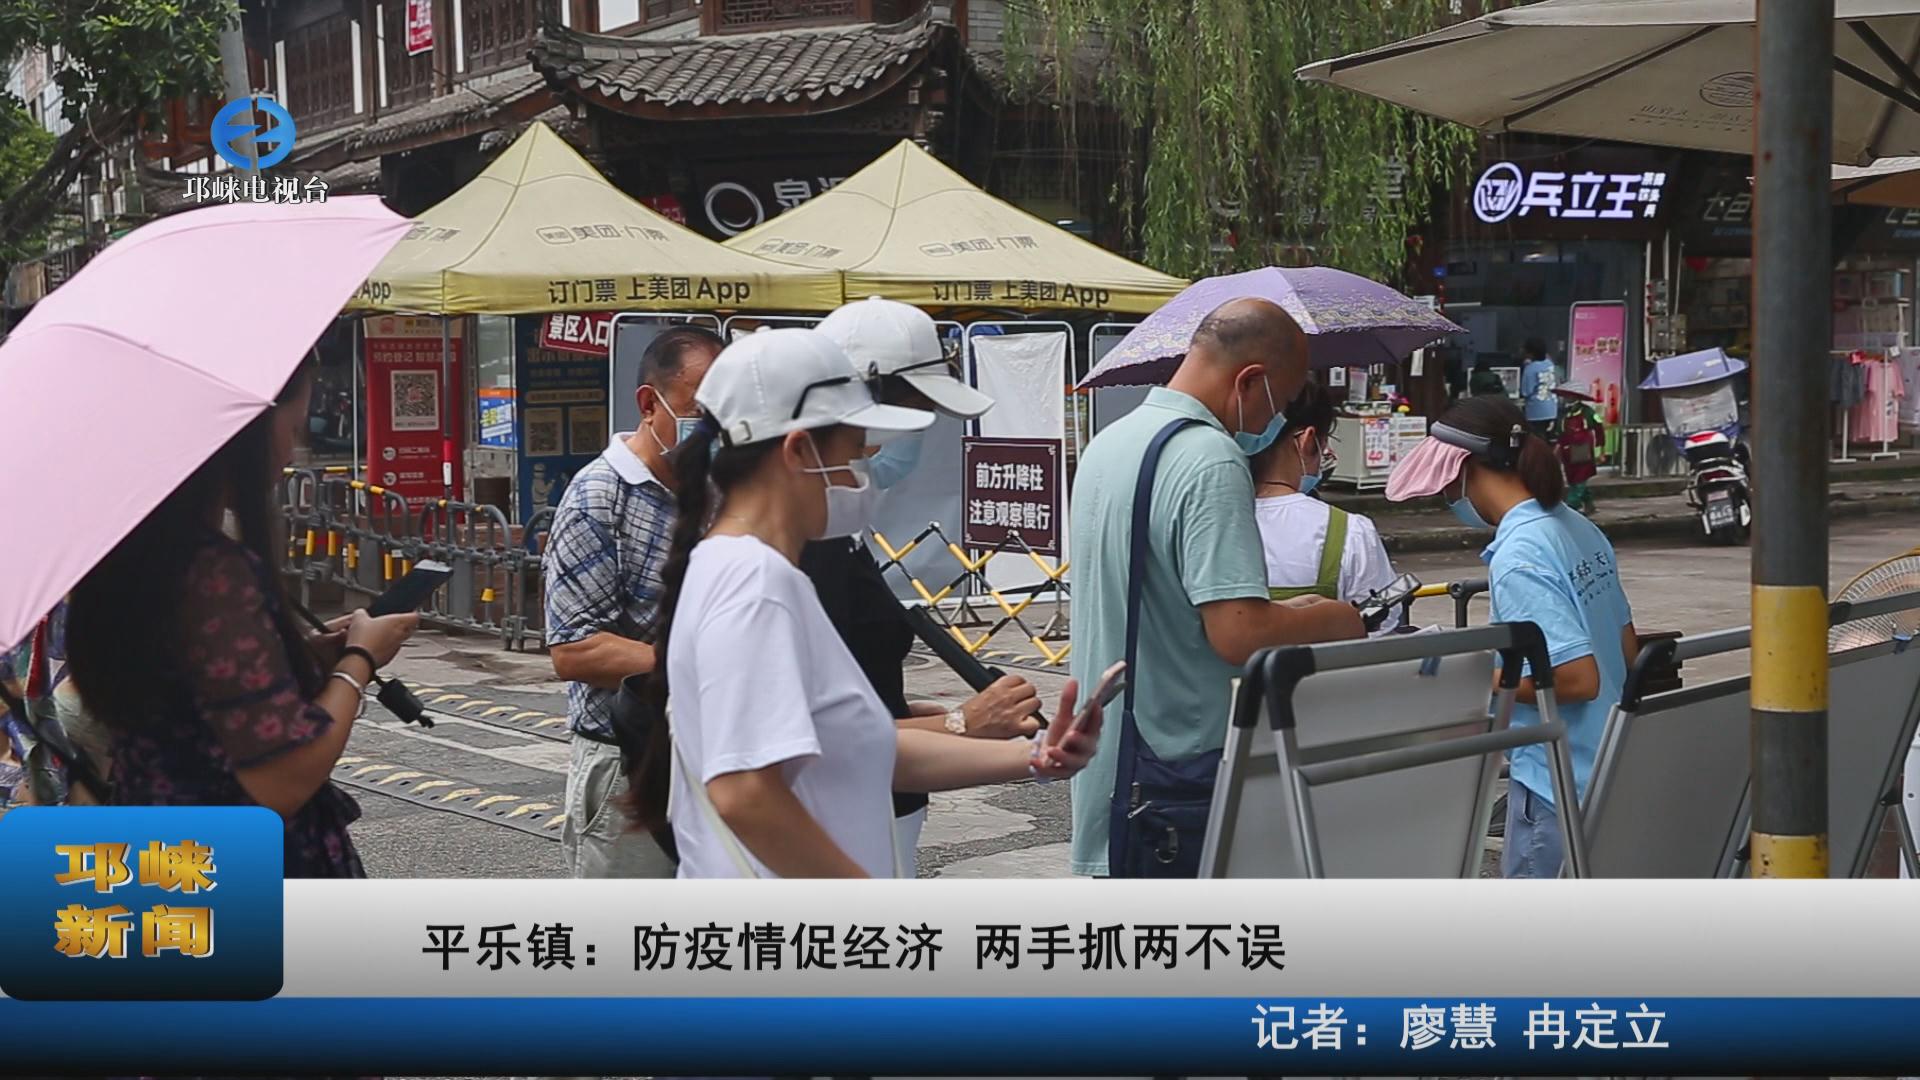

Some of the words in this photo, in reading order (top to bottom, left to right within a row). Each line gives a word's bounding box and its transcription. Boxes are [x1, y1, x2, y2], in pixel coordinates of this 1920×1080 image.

[1518, 170, 1643, 220] 兵立王
[548, 278, 617, 304] 订门票
[933, 280, 993, 302] 订门票
[547, 313, 611, 348] 景区入口
[975, 462, 1045, 491] 前方升降柱
[968, 499, 1051, 530] 注意观察慢行
